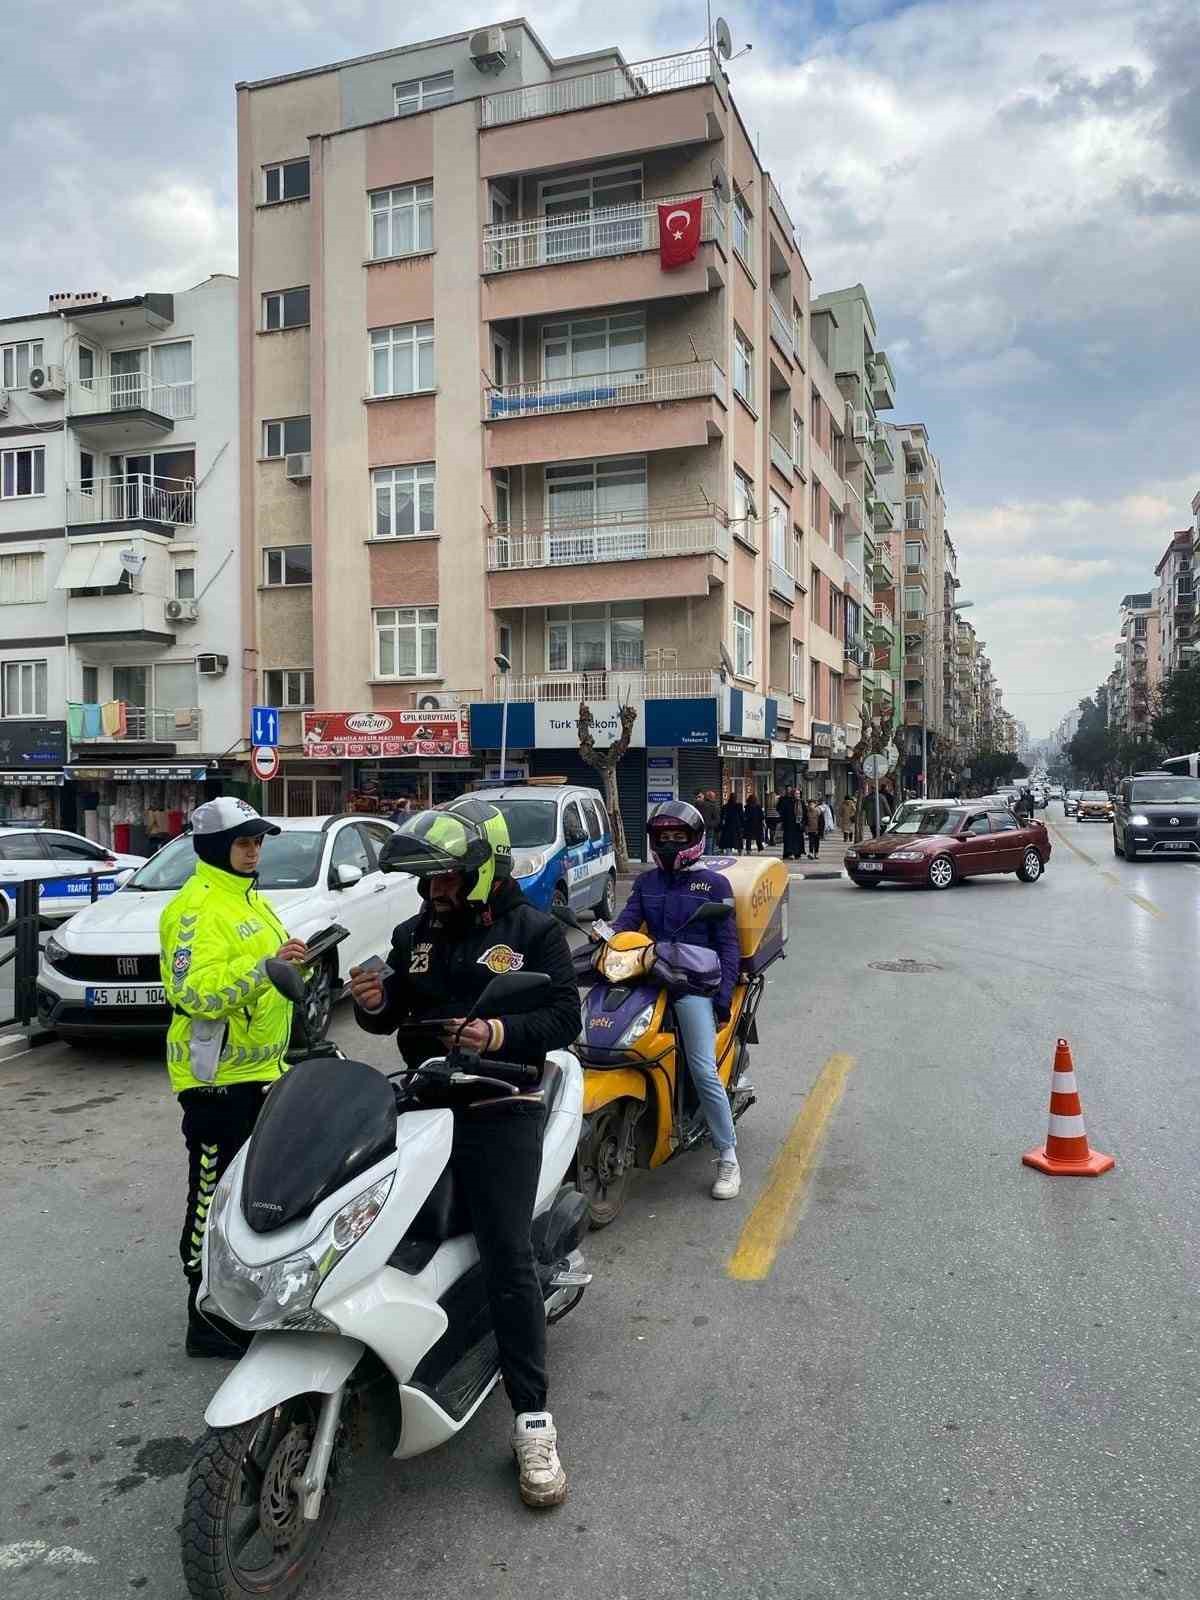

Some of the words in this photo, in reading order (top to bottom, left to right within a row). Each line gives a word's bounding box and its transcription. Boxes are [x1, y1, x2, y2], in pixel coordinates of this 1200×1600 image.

[550, 719, 572, 729] Türk
[689, 881, 712, 893] getir
[751, 877, 775, 919] getir
[116, 957, 139, 976] FIAT
[408, 949, 429, 974] 23
[94, 989, 108, 1004] 45
[115, 989, 137, 1004] AHJ
[145, 989, 165, 1003] 104
[590, 1014, 614, 1029] getir
[525, 1419, 547, 1430] PUMA
